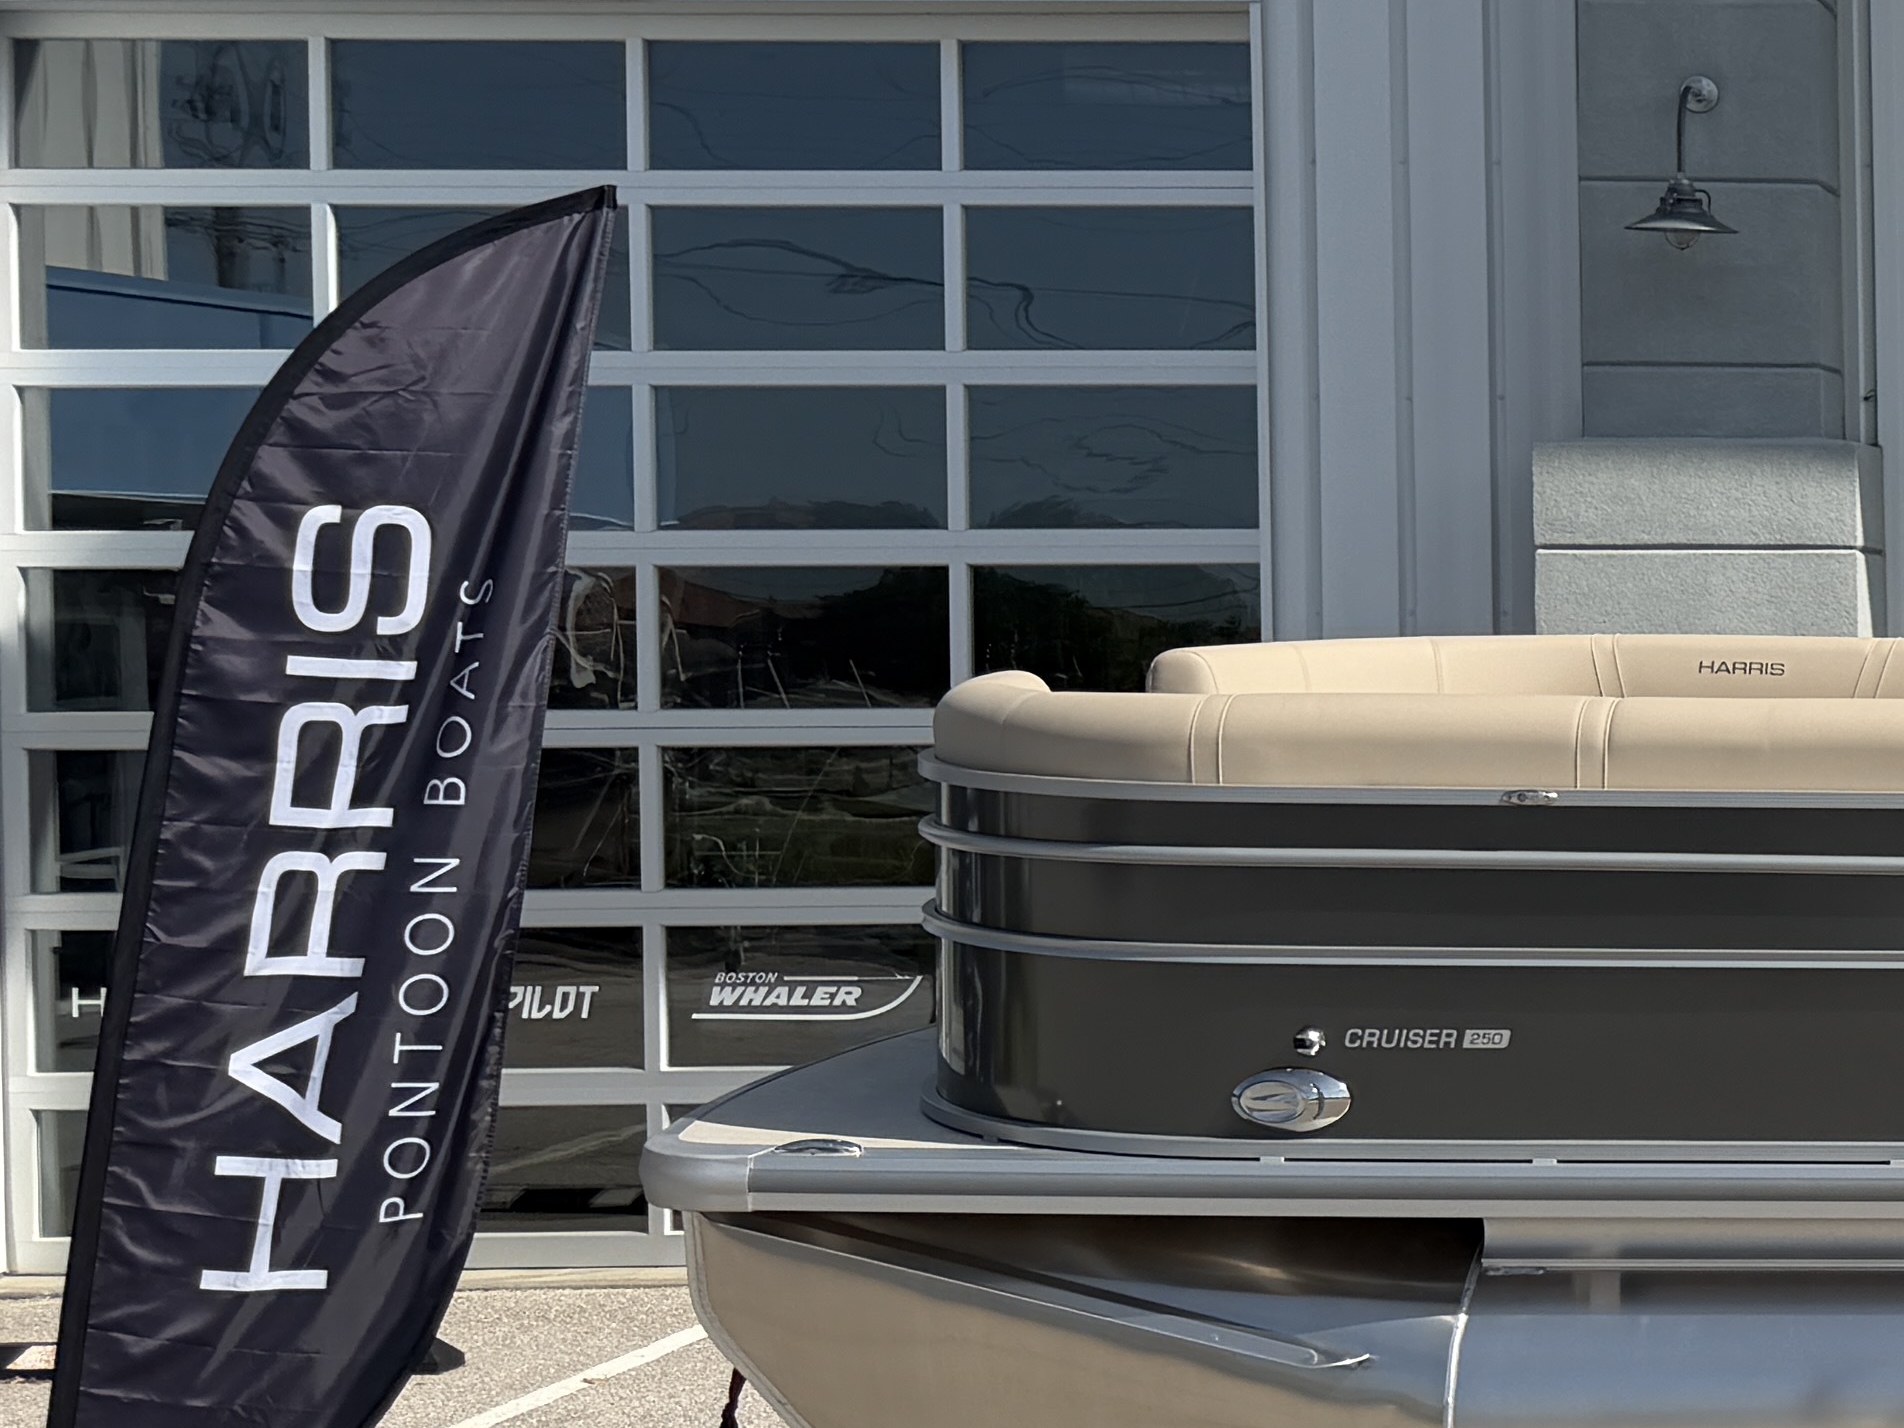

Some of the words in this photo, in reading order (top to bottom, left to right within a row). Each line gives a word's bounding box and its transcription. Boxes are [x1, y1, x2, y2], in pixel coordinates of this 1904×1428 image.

[1698, 660, 1786, 677] HARRIS
[199, 503, 432, 1292] HARRIS
[380, 856, 460, 1224] PONTOON
[424, 579, 494, 807] BOATS
[714, 972, 779, 984] BOSTON
[709, 985, 863, 1006] WHALER
[1344, 1028, 1458, 1049] CRUISER
[1467, 1031, 1505, 1046] 250
